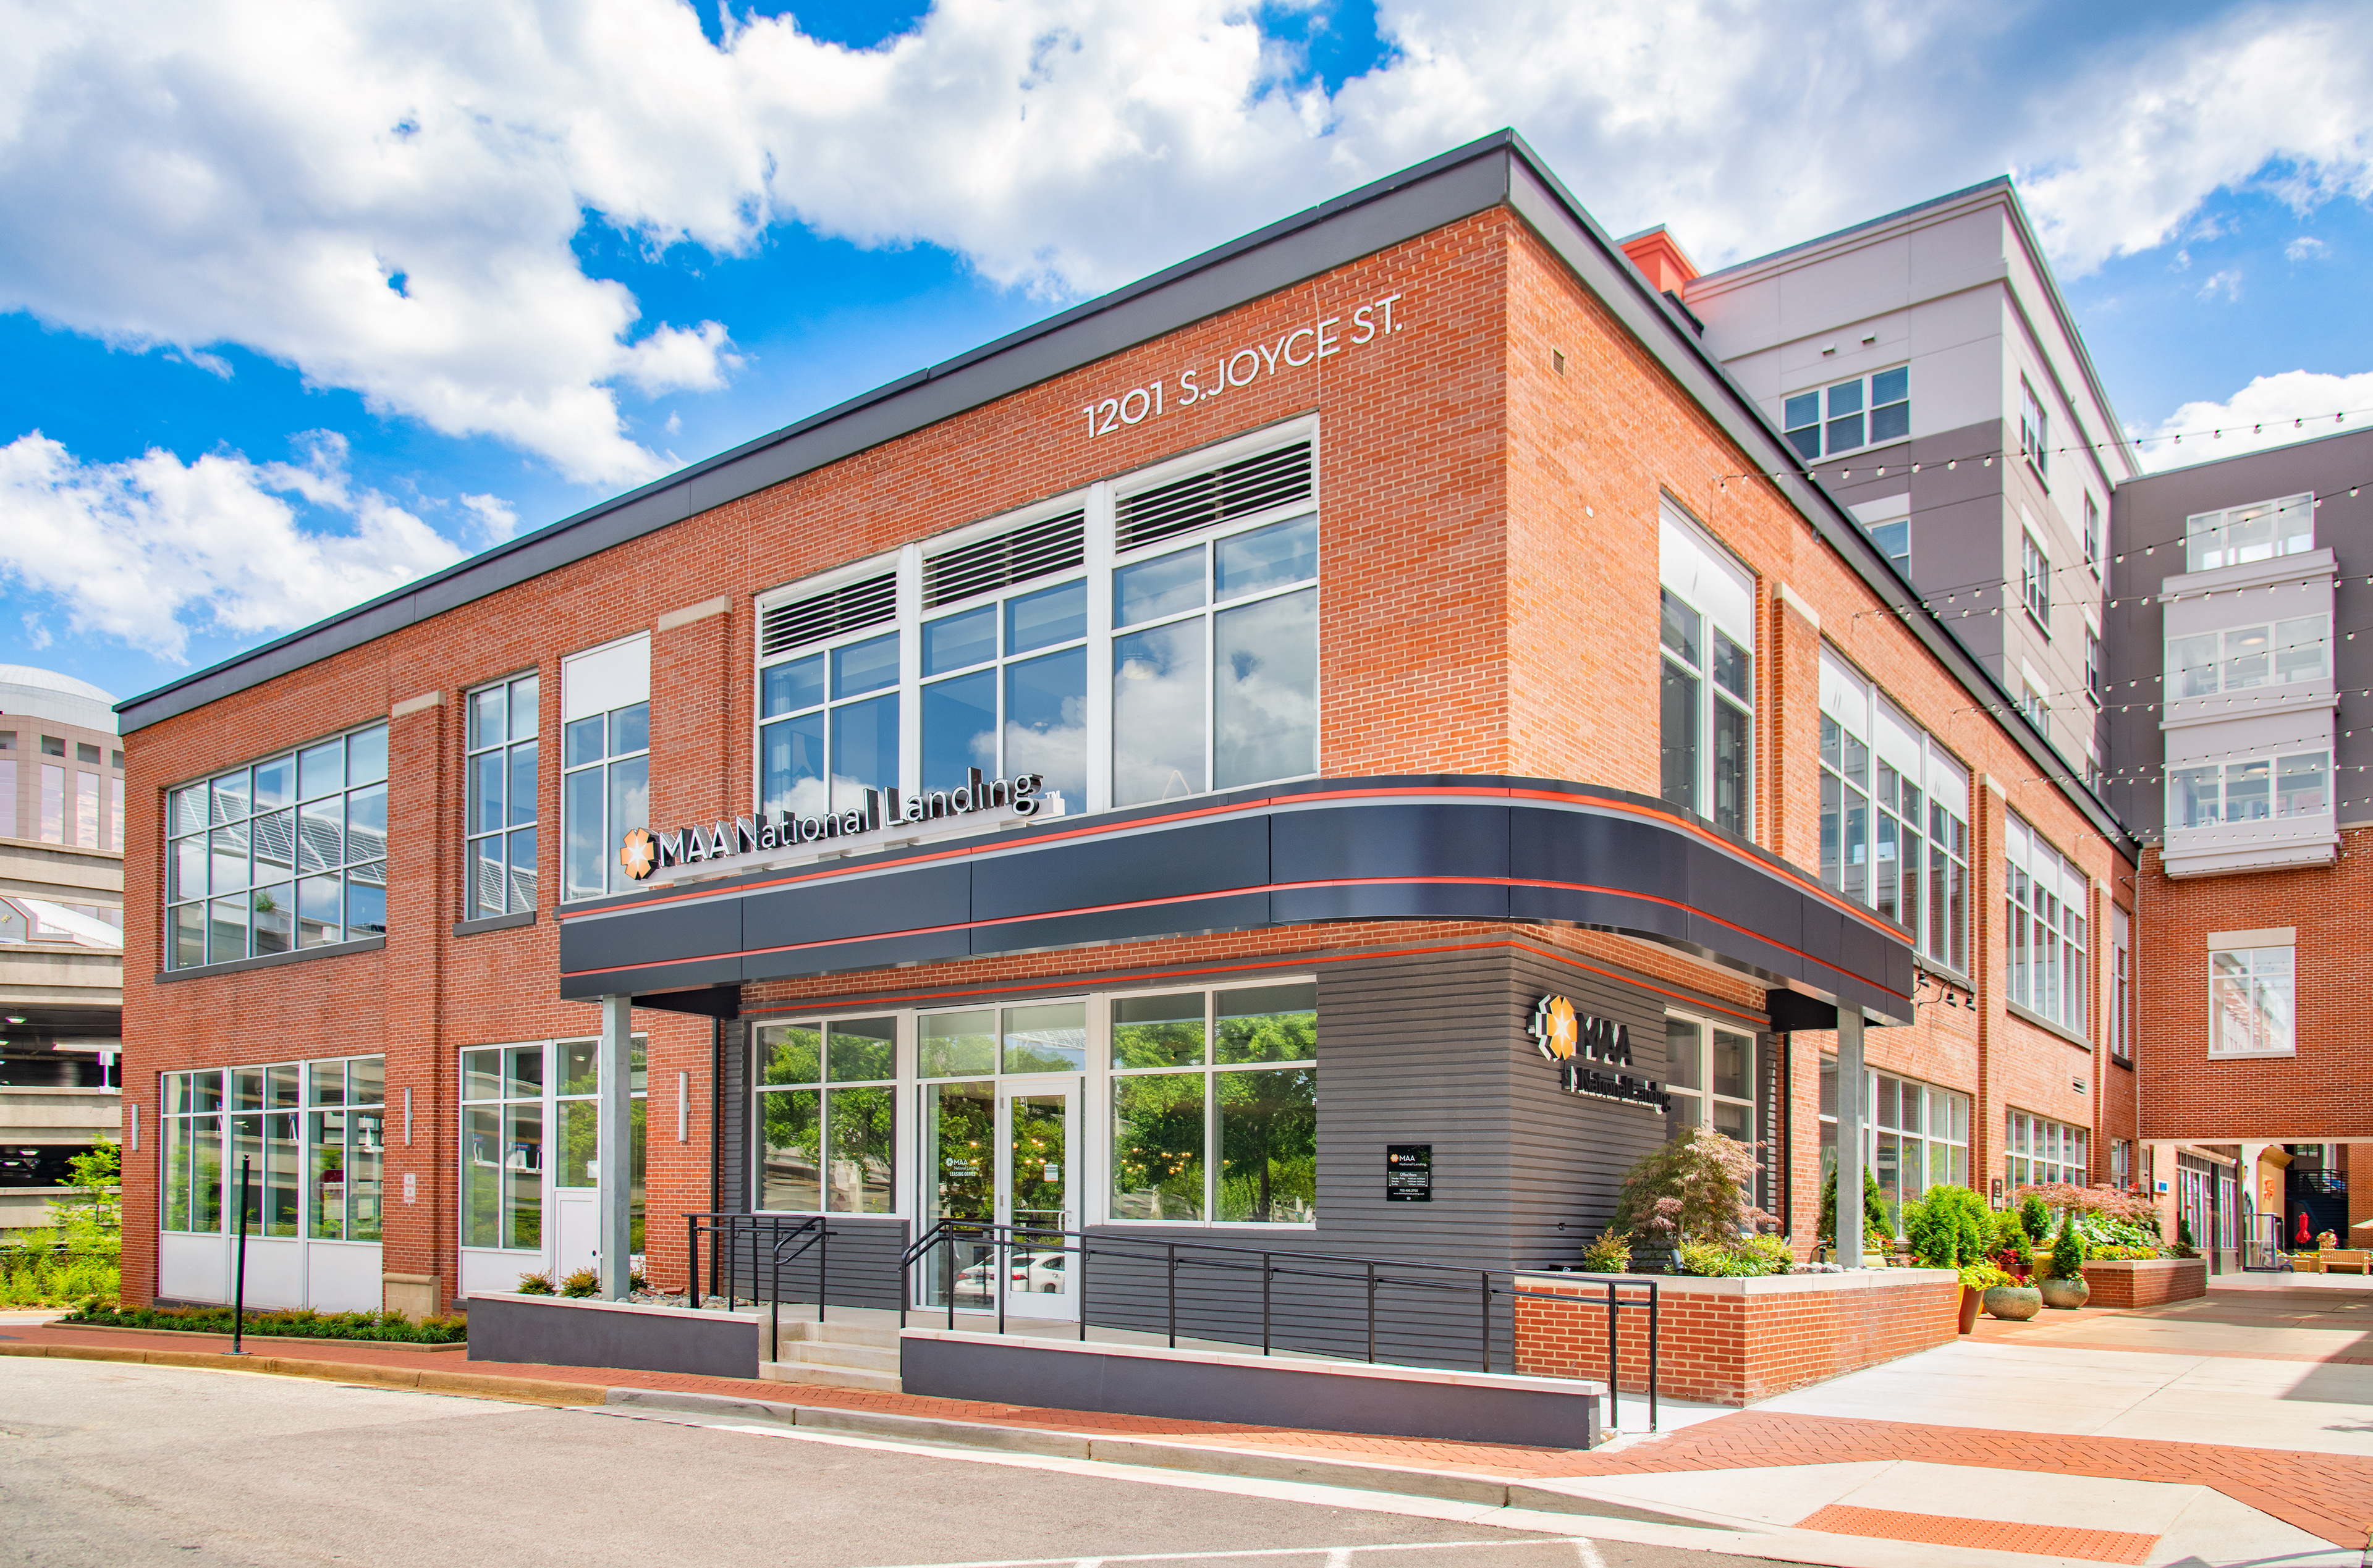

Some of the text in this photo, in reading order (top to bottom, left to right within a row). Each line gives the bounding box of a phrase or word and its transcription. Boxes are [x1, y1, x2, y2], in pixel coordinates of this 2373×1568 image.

[1083, 381, 1162, 438] 1201
[1351, 293, 1403, 344] ST.
[659, 820, 732, 867] MAA
[735, 788, 875, 853] National
[884, 767, 1041, 828] Landing
[1576, 1013, 1633, 1066] MAA
